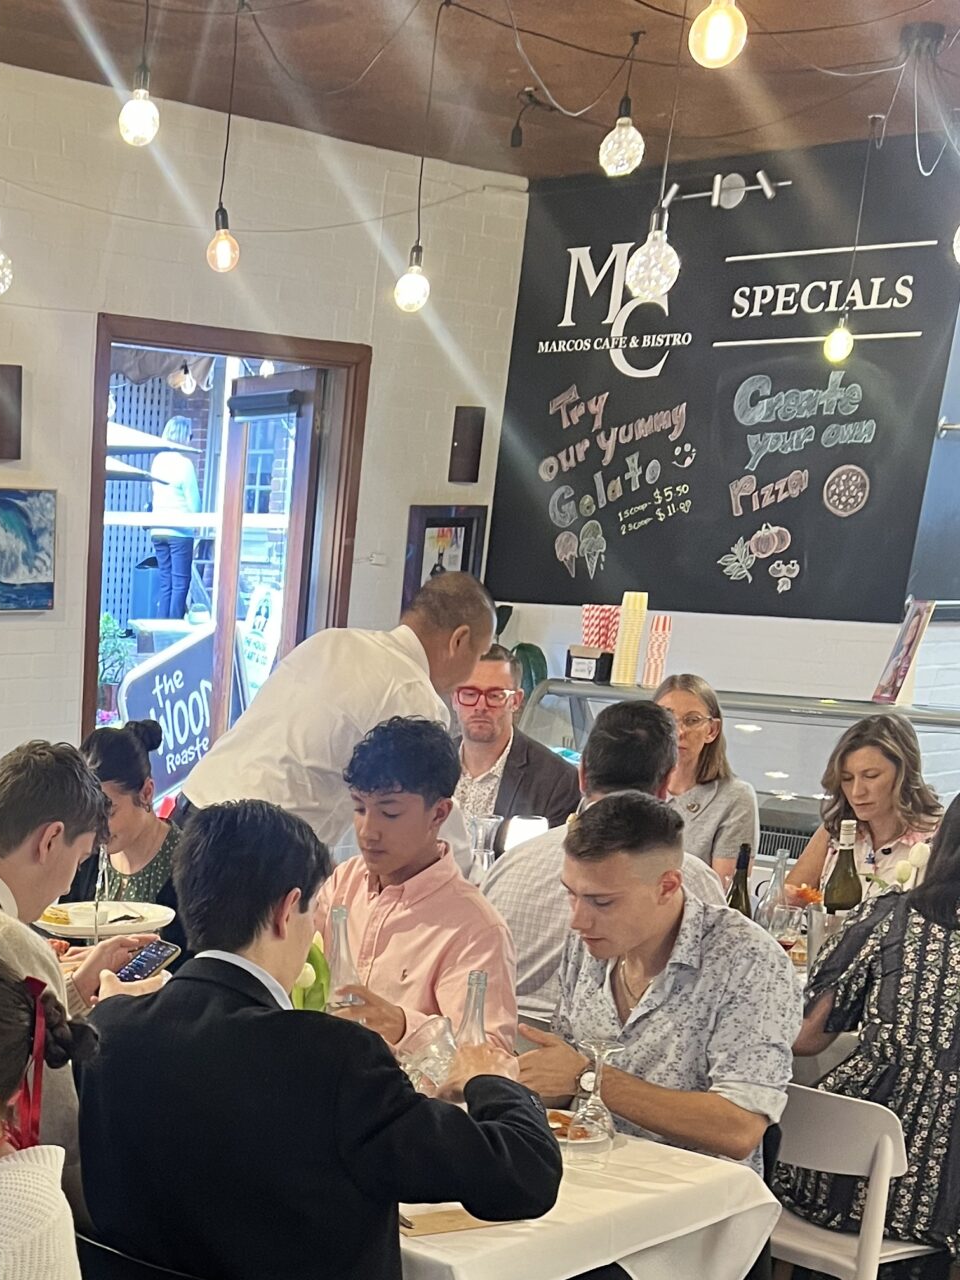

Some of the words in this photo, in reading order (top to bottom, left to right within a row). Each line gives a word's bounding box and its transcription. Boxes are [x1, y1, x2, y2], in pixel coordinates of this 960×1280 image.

[731, 275, 914, 318] SPECIALS
[537, 338, 591, 353] MARCOS
[593, 336, 627, 350] CAFE
[629, 335, 640, 348] &
[642, 332, 692, 348] BISTRO
[549, 384, 609, 432] Try
[733, 371, 862, 426] Create
[538, 438, 590, 482] our
[596, 402, 687, 466] yummy
[744, 425, 815, 471] your
[821, 419, 876, 448] own
[549, 451, 661, 528] Gelato
[729, 469, 809, 517] Pizza
[152, 670, 184, 708] the
